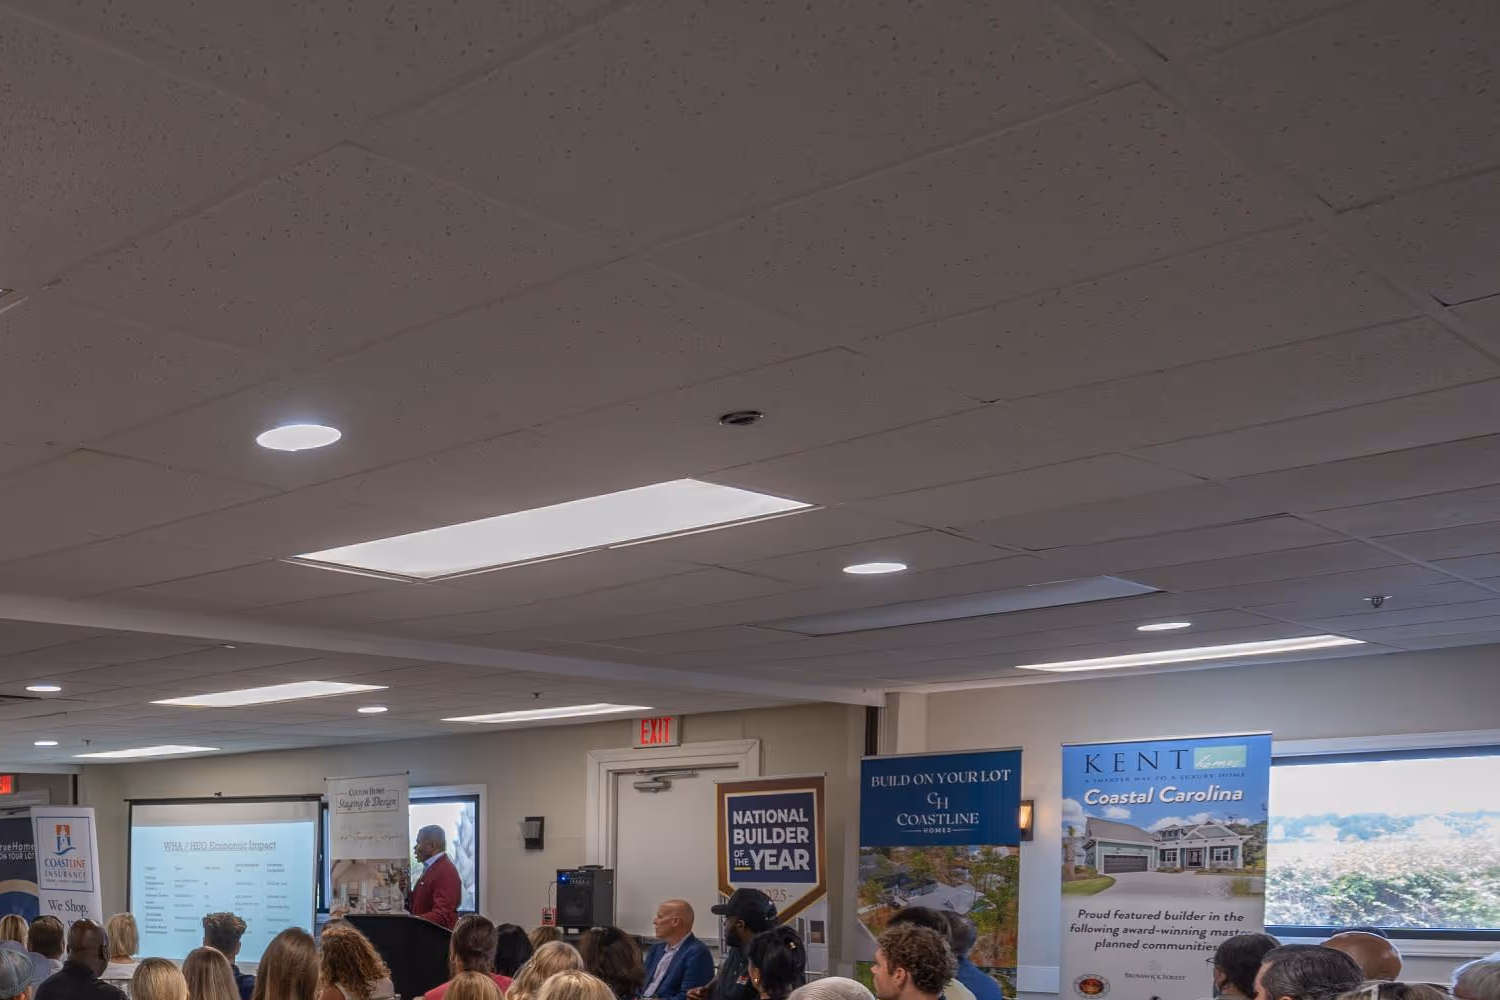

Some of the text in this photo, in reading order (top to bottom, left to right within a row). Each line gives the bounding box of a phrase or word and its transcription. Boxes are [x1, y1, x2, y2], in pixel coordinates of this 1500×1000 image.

[641, 716, 675, 745] EXIT
[1084, 750, 1188, 774] KENT
[871, 769, 1011, 788] BUILD ON YOUR LOT
[338, 796, 397, 811] Staging & Design
[1084, 784, 1244, 806] Coastal Carolina
[732, 808, 809, 825] NATIONAL
[896, 812, 980, 826] COASTLINE
[733, 826, 810, 845] BUILDER
[163, 841, 182, 851] WHA
[209, 840, 247, 851] Economic
[249, 840, 277, 852] Impact
[8, 852, 23, 860] YOUR
[44, 858, 86, 869] COASTLINE
[734, 849, 810, 871] OF THE YEAR
[44, 870, 86, 879] INSURANCE
[47, 898, 88, 917] We Shop,
[1078, 909, 1245, 922] Proud featured builder in the
[1070, 923, 1120, 938] following
[1122, 925, 1207, 940] award-winning
[1095, 939, 1139, 951] planned
